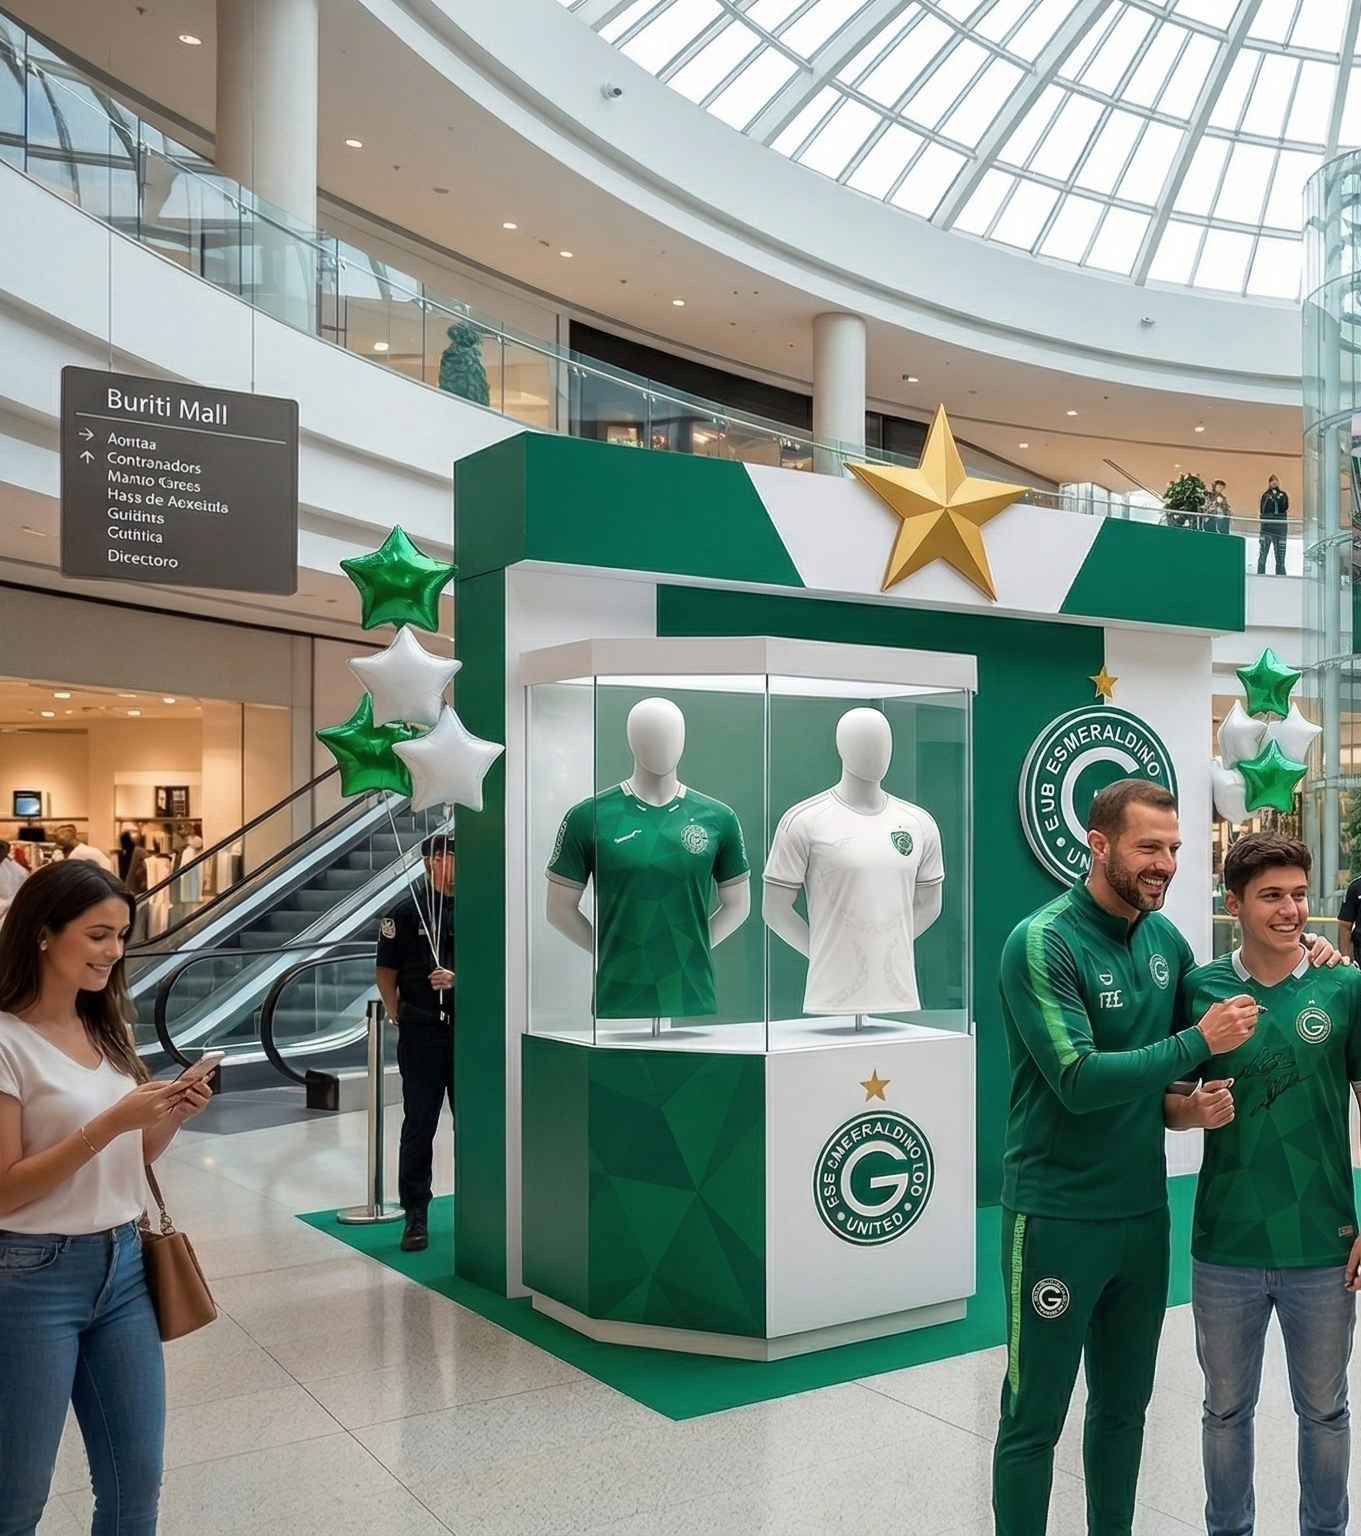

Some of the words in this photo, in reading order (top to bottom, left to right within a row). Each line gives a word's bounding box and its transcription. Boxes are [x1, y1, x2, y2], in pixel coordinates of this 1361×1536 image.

[108, 388, 171, 417] Buriti
[180, 399, 227, 425] Mall
[1046, 724, 1161, 777] ESMERALDINO
[1303, 1014, 1324, 1036] G
[841, 1140, 909, 1217] G
[846, 1212, 903, 1235] UNITED
[1039, 1286, 1062, 1310] G
